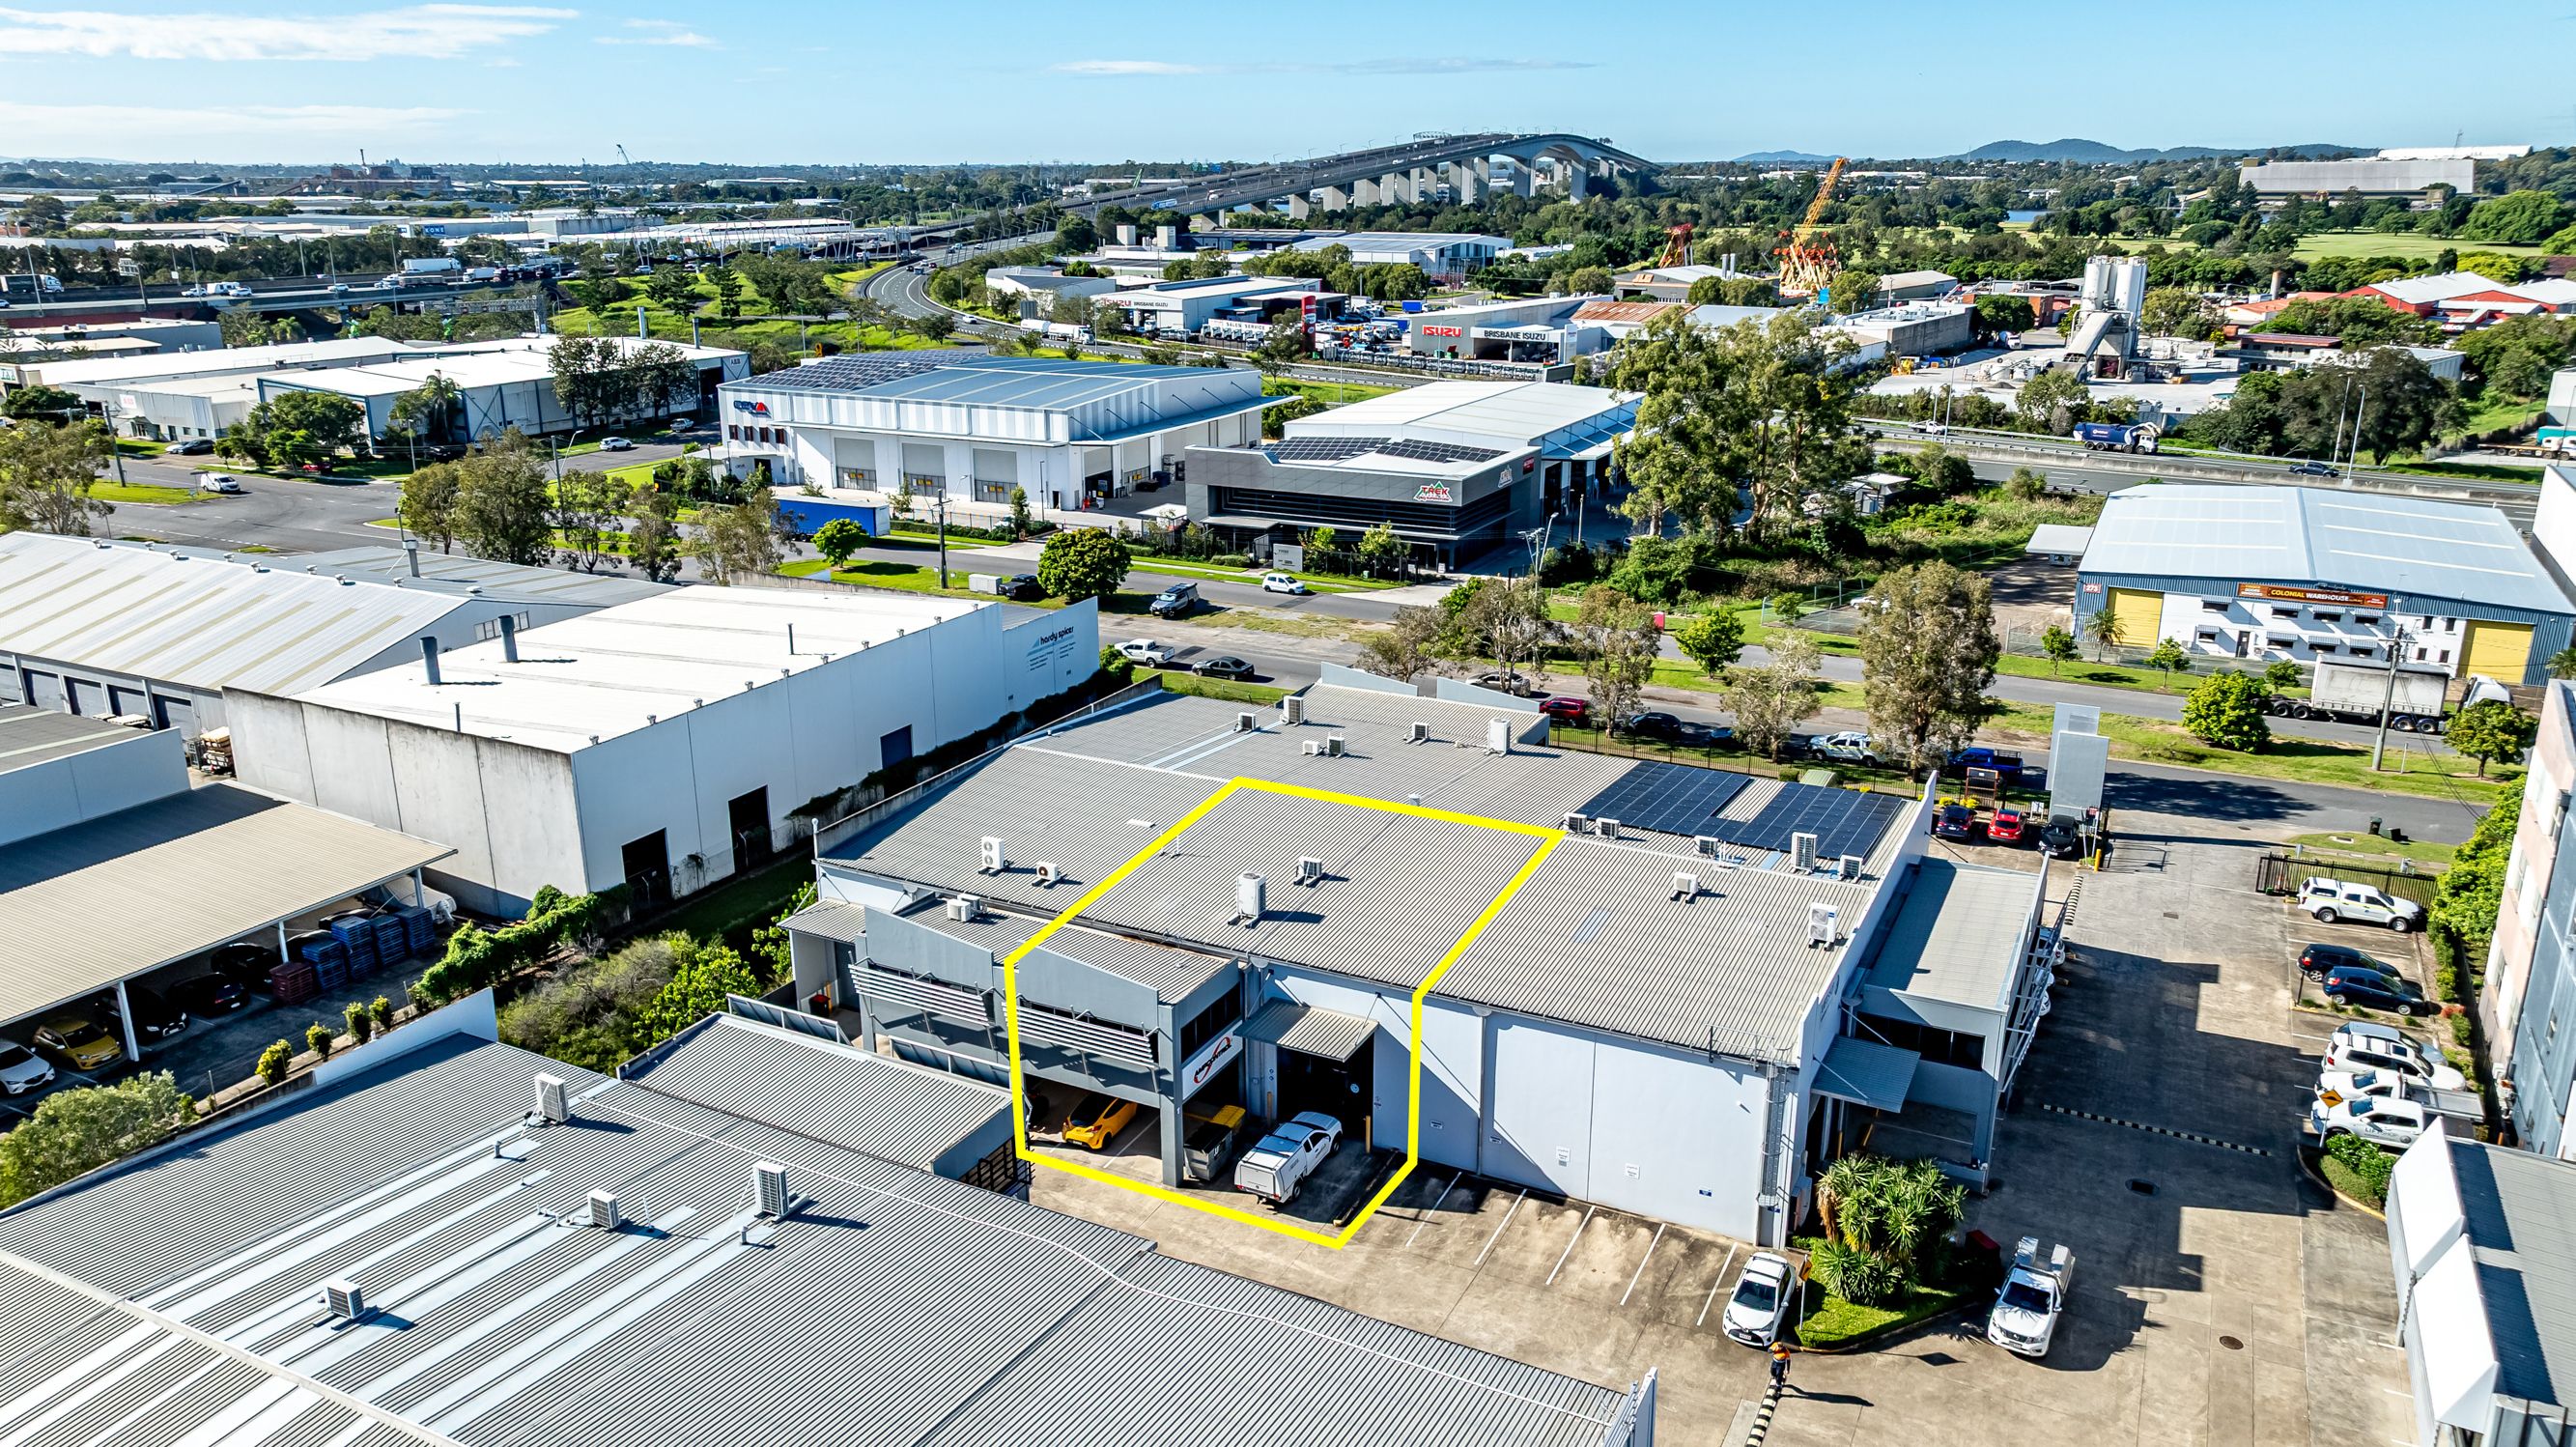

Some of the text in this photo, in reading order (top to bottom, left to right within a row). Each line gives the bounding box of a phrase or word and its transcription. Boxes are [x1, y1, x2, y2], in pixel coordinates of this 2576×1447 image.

[1423, 326, 1461, 337] ISUZU
[1484, 329, 1546, 340] BRISBANE ISUZU
[1422, 486, 1448, 496] TREK
[2271, 589, 2349, 602] COLONIAL WAREHOUSE
[1040, 626, 1074, 646] hardy spicer
